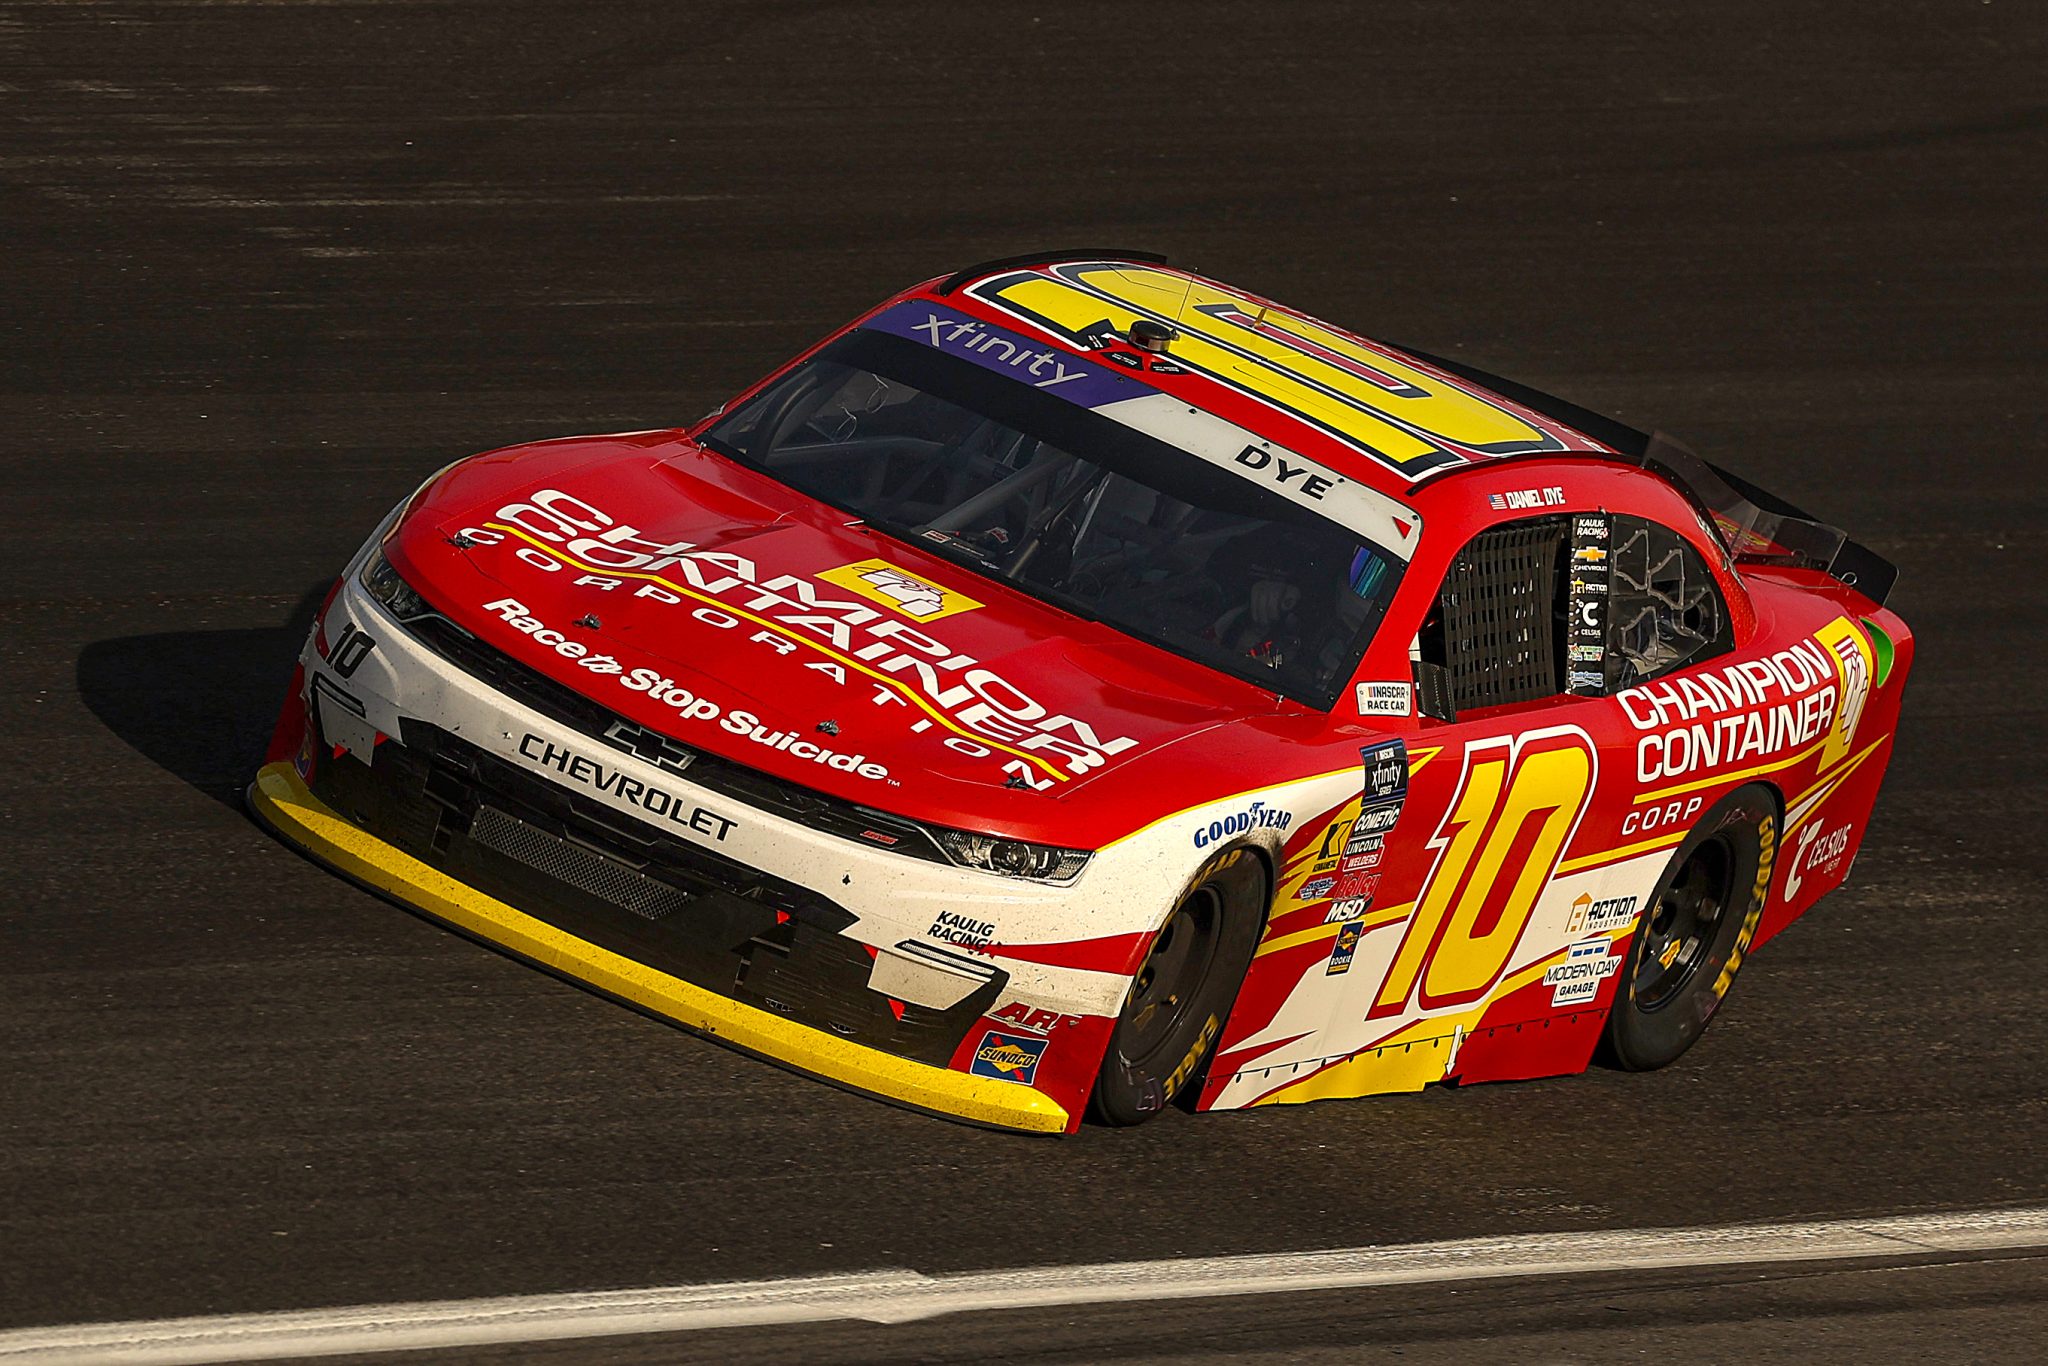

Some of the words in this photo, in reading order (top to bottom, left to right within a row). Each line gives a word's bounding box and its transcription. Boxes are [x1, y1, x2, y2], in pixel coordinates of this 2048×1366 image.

[911, 313, 1089, 387] xfinity
[1234, 443, 1335, 501] DYE
[1505, 489, 1545, 509] DANIEL
[1542, 486, 1566, 506] DYE
[1576, 527, 1605, 536] RACING
[1578, 518, 1605, 527] KAULIG
[529, 488, 1140, 757] CHAMPION
[325, 621, 377, 680] 10
[496, 504, 1107, 775] CONTAINER
[461, 527, 1056, 792] CORPORATION
[482, 597, 588, 659] Race
[577, 653, 624, 677] to
[620, 668, 721, 721] Stop
[719, 710, 890, 781] Suicide
[1375, 686, 1406, 699] NASCAR
[1616, 639, 1833, 730] CHAMPION
[1367, 700, 1389, 710] RACE
[1390, 701, 1405, 711] CAR
[1637, 685, 1836, 783] CONTAINER
[518, 732, 739, 842] CHEVROLET
[1371, 761, 1402, 792] xfinity
[1193, 808, 1293, 849] GOODYEAR
[1354, 807, 1400, 832] COMETIC
[1621, 796, 1703, 836] CORP
[1345, 837, 1379, 855] LINCOLN
[1347, 853, 1379, 868] WELDERS
[1366, 725, 1598, 1020] 10
[1324, 899, 1366, 923] MSD
[1587, 896, 1637, 921] ACTION
[927, 923, 989, 950] RACING
[936, 910, 995, 937] KAULIG
[1584, 916, 1633, 930] INDUSTRIES
[1544, 962, 1597, 983] MODERN
[1595, 958, 1621, 980] DAY
[1559, 981, 1595, 996] GARAGE
[980, 1048, 1036, 1067] SUNOCO
